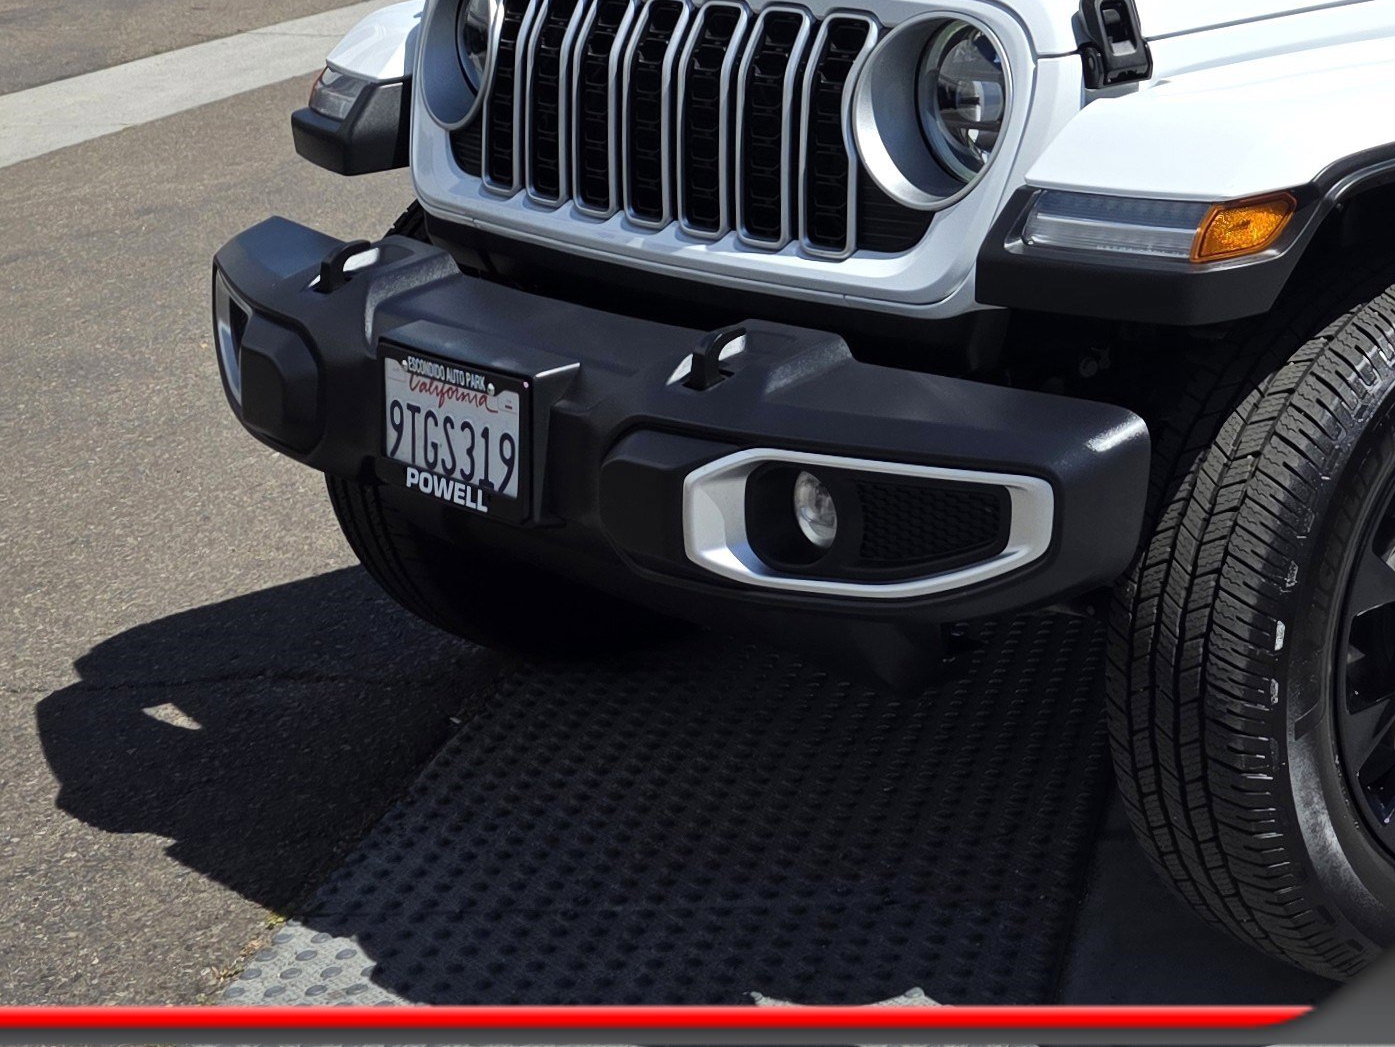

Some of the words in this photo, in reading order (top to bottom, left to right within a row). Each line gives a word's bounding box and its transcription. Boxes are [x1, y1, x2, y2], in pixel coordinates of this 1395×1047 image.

[407, 355, 446, 381] ESCONDIDO
[446, 367, 466, 386] AUTO
[466, 372, 486, 392] PARK
[409, 373, 499, 414] California
[389, 399, 517, 494] 9TGS319
[406, 466, 489, 513] POWELL
